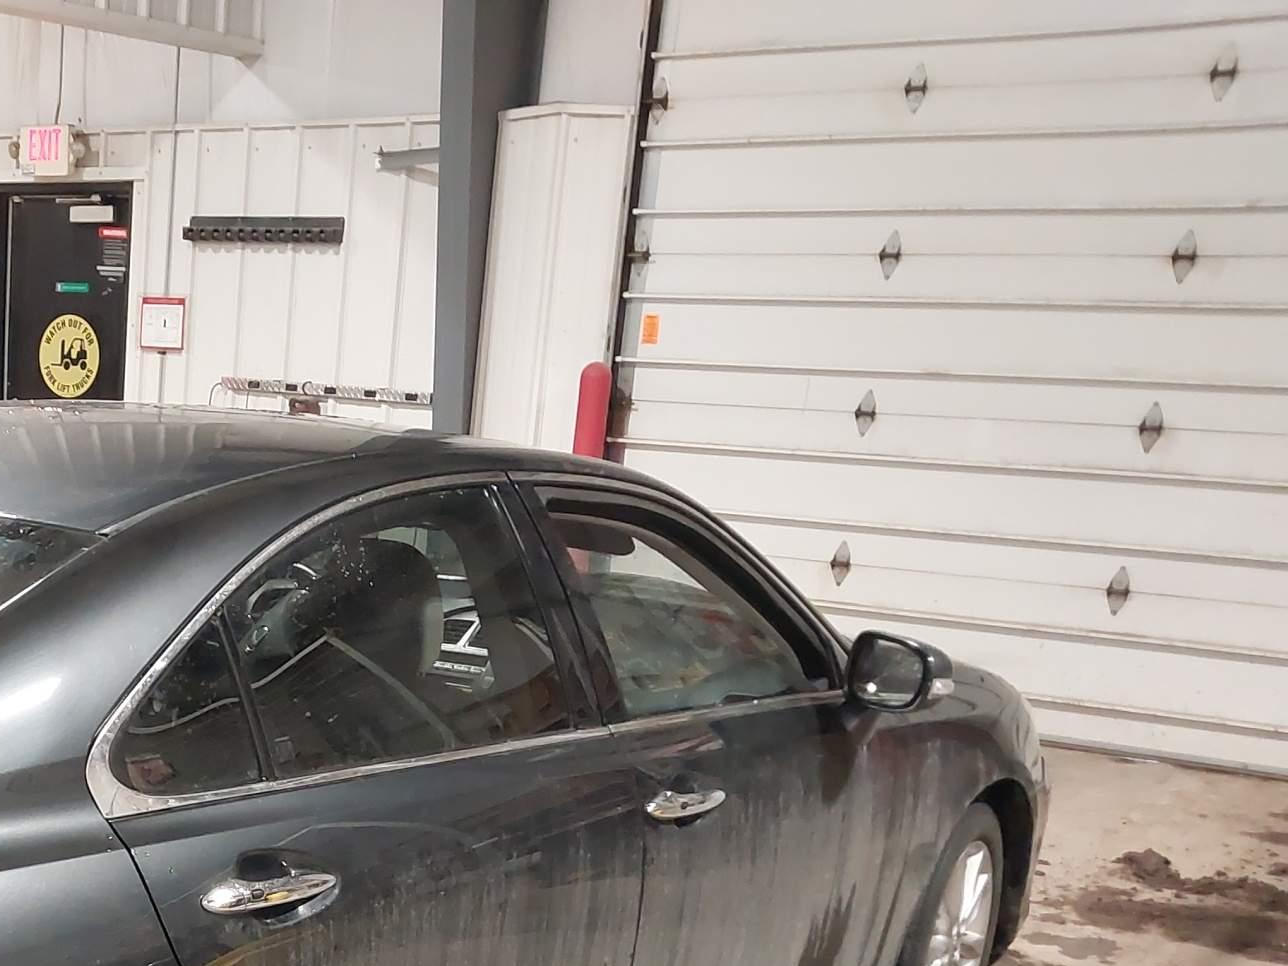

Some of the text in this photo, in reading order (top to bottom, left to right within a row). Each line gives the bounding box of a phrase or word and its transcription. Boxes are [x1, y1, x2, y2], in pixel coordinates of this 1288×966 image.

[29, 129, 62, 161] EXIT
[44, 318, 95, 346] WATCH OUT FOR
[43, 365, 95, 393] FORK LIFT TRUCKS
